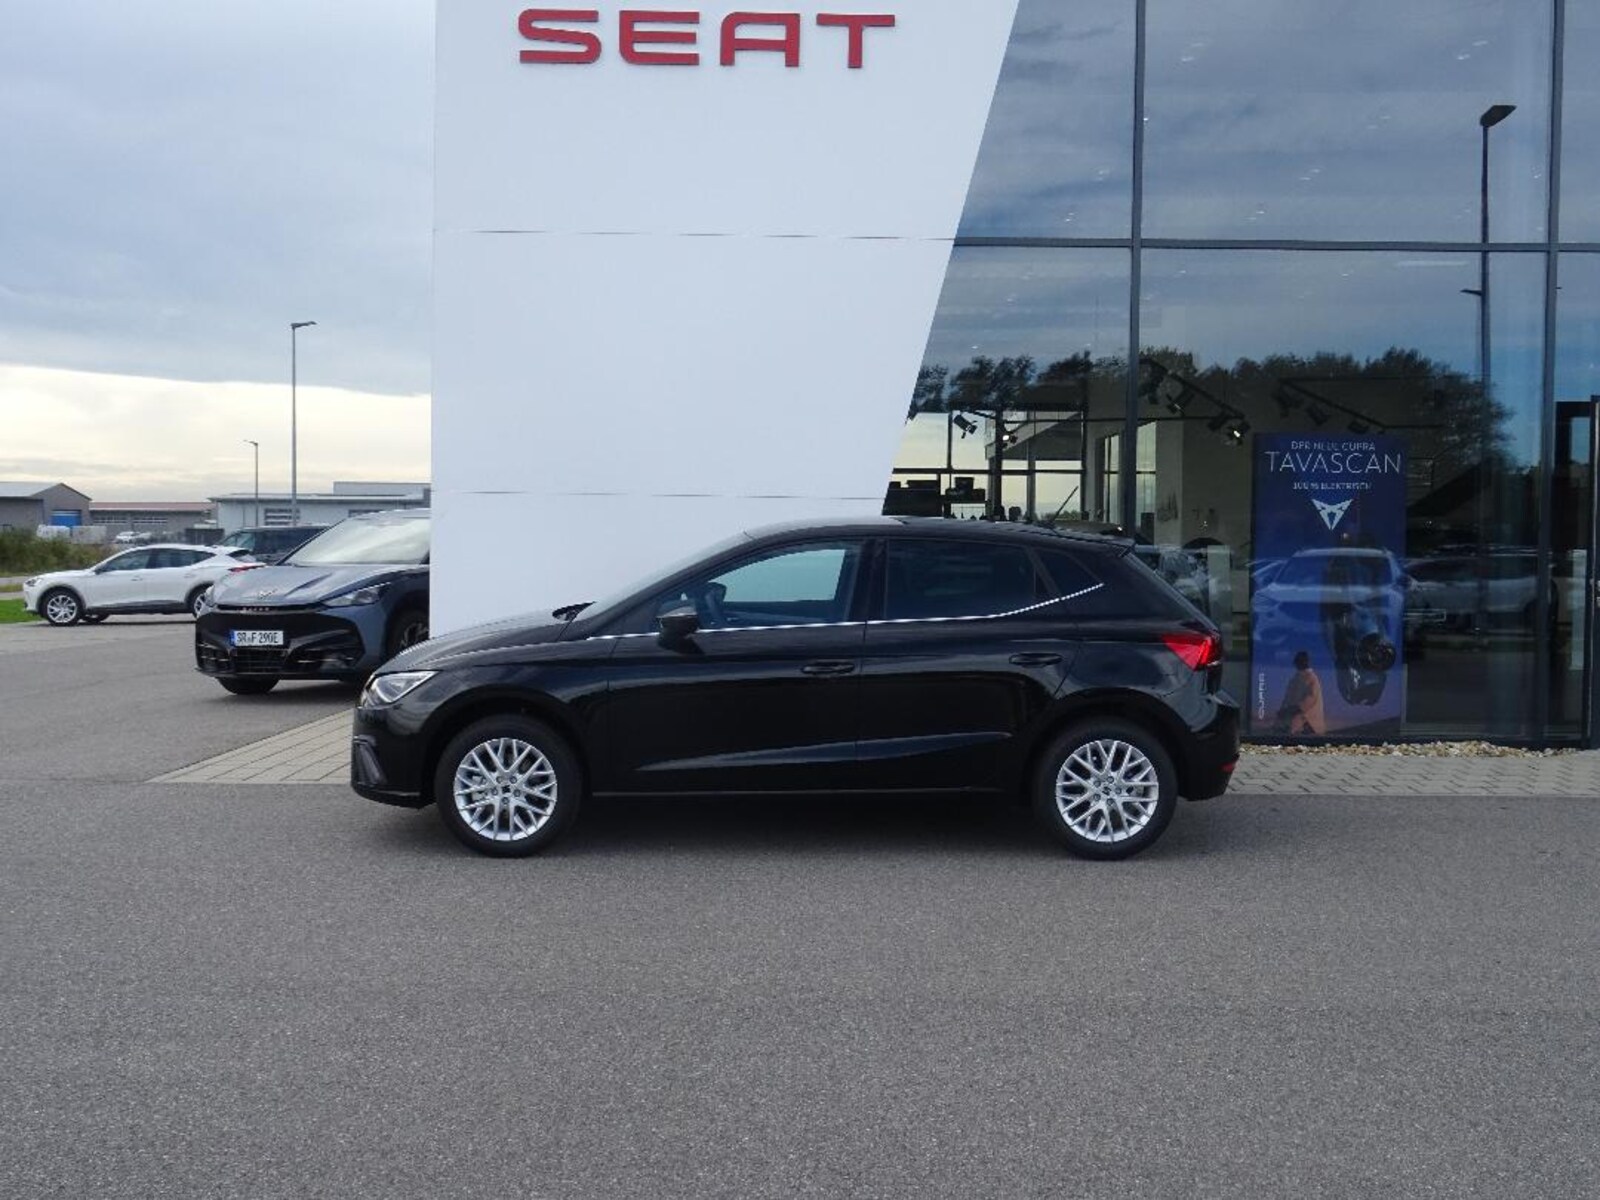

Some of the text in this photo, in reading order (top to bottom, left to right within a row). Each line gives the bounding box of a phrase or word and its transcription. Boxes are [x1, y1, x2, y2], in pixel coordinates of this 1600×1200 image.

[518, 8, 896, 69] SEAT
[1341, 442, 1376, 451] CUPRA
[1264, 451, 1402, 474] TAVASCAN
